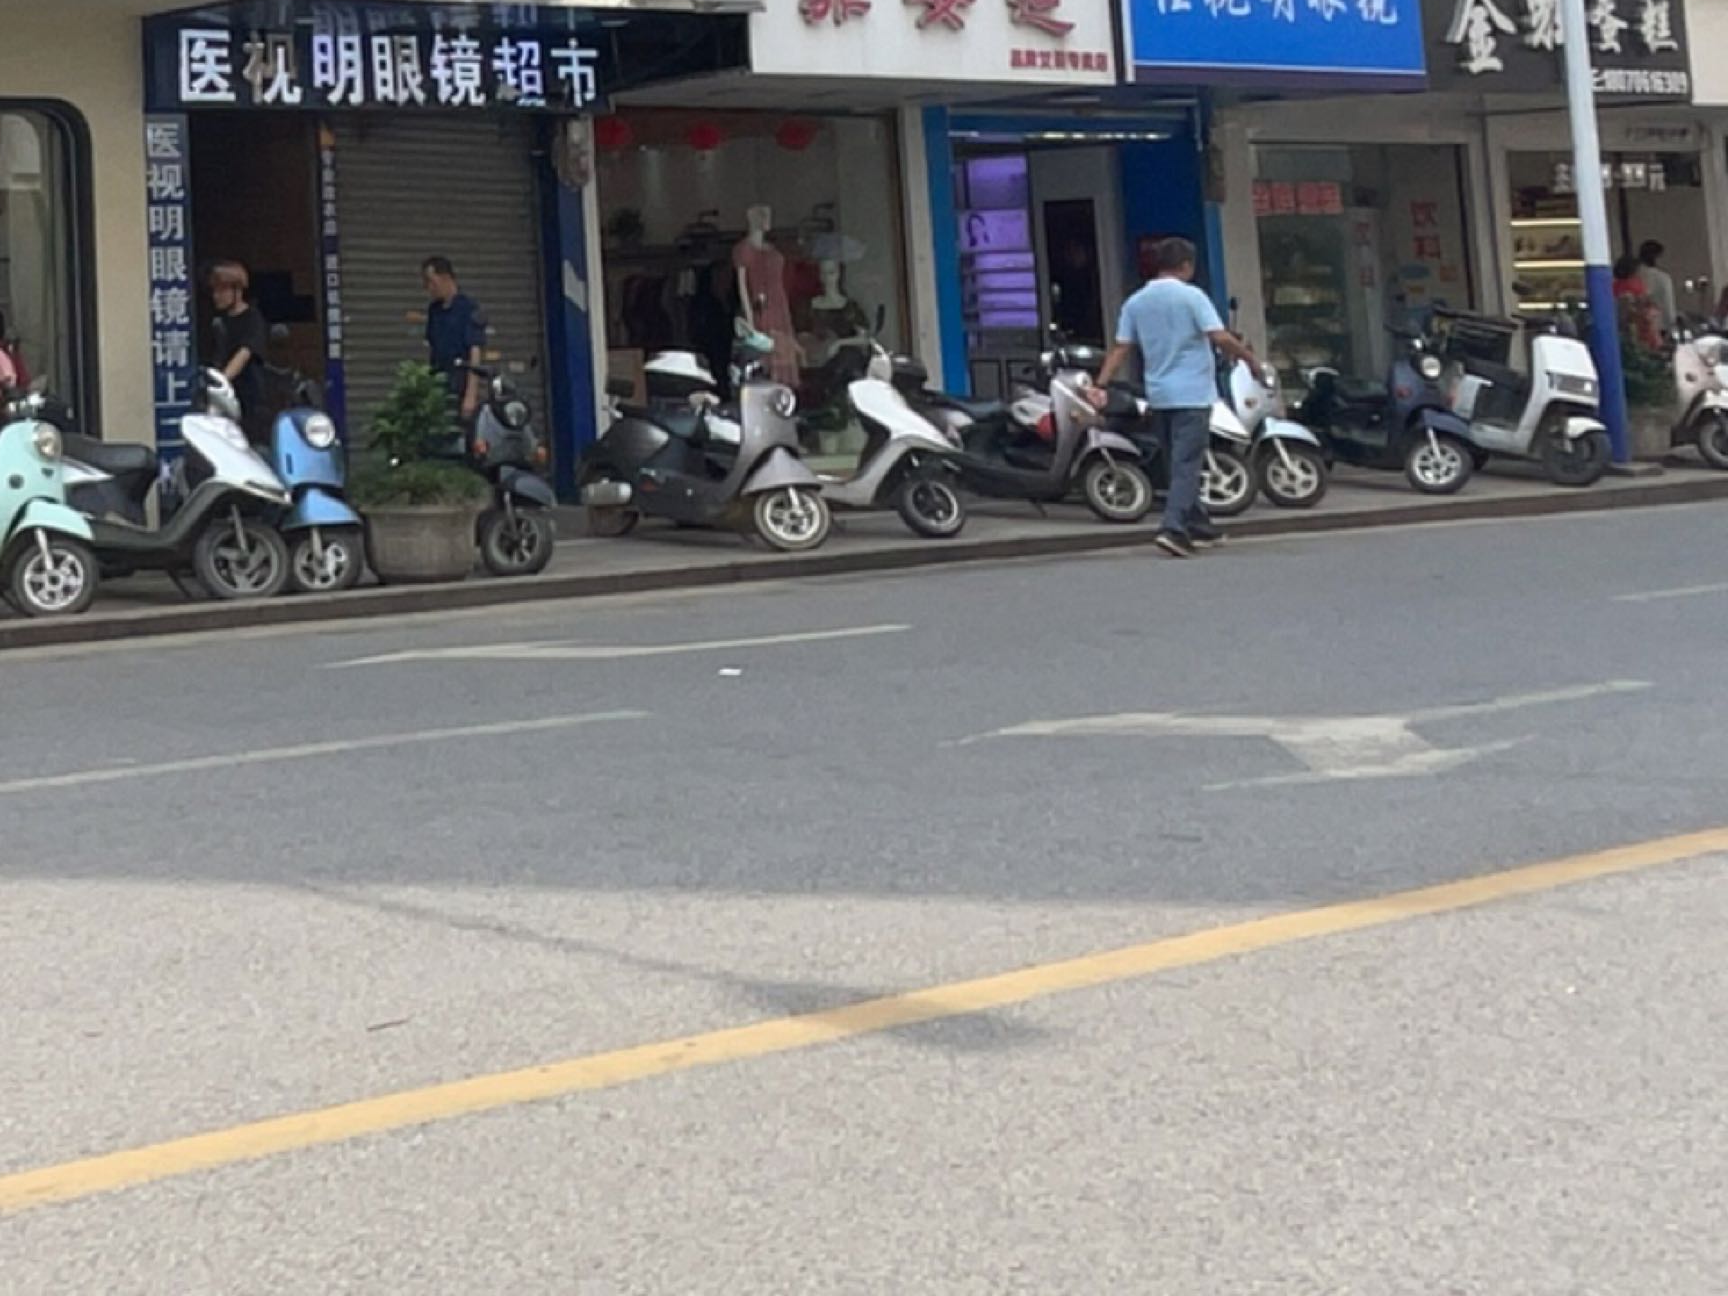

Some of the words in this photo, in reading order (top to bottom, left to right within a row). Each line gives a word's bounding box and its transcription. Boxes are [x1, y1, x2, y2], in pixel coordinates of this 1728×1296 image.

[178, 28, 599, 108] 医视明眼镜超市
